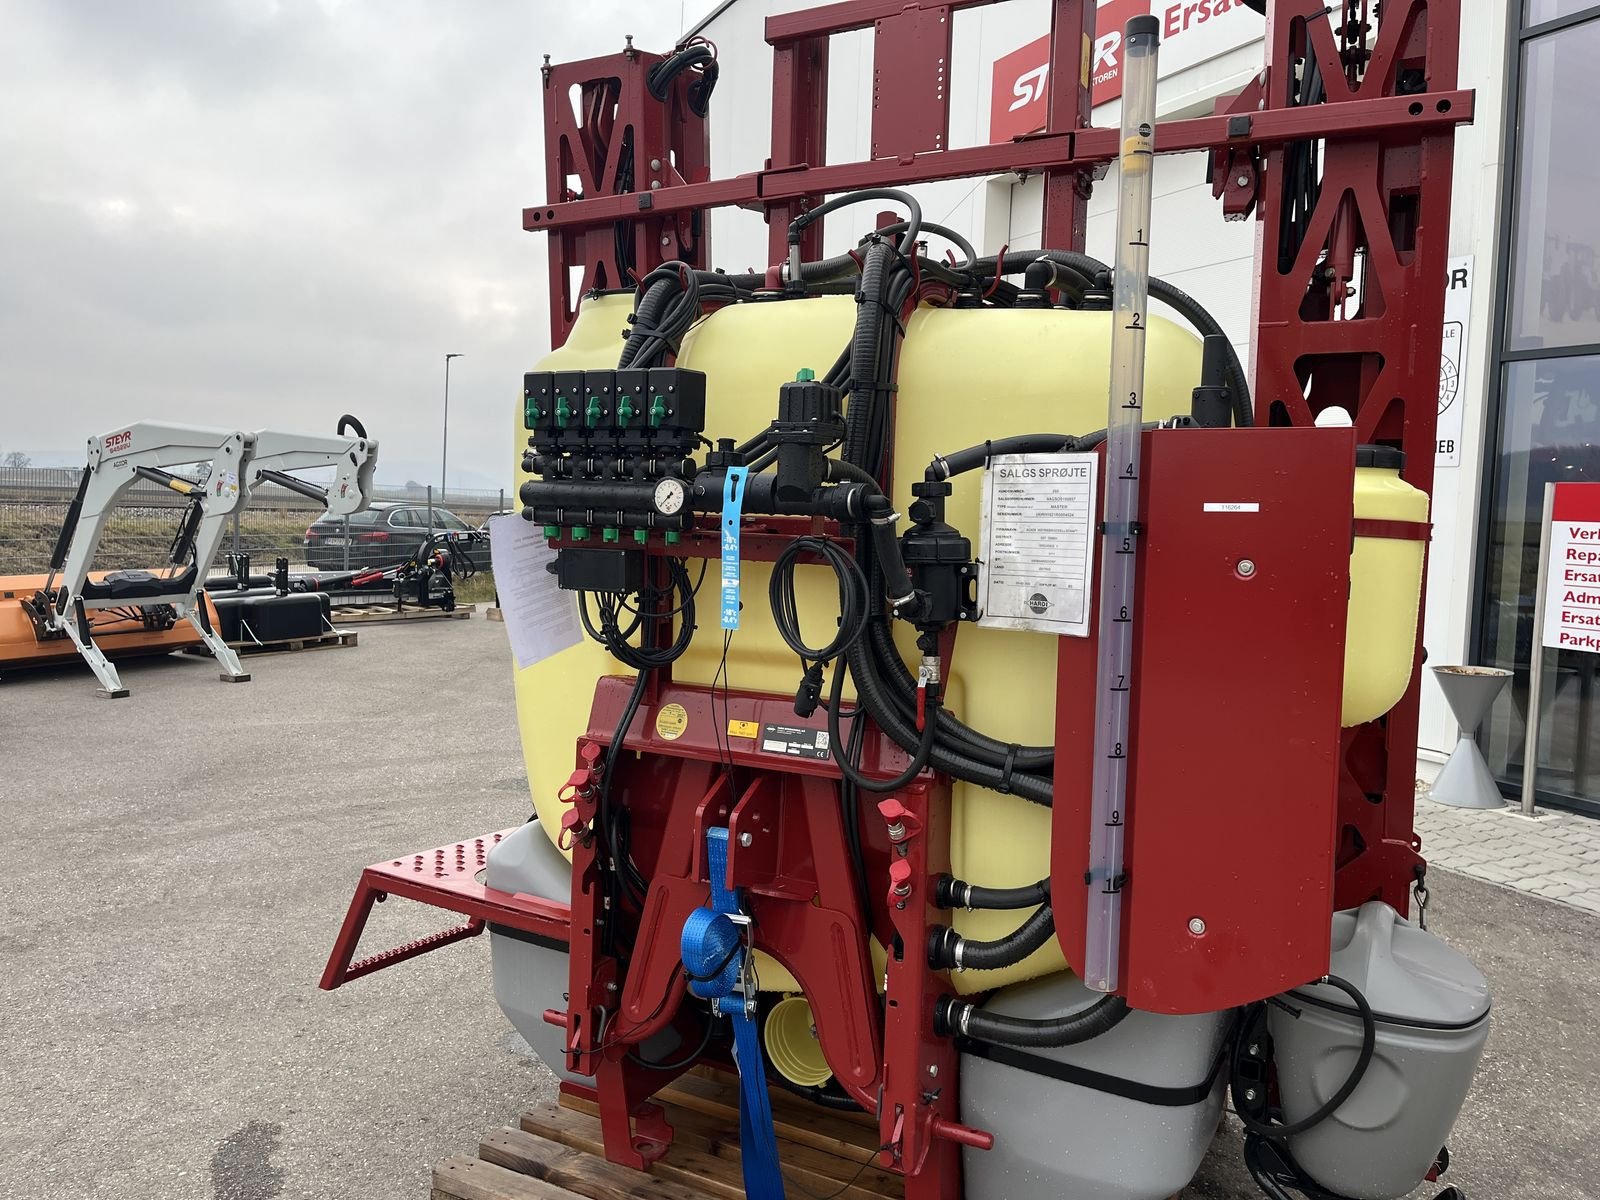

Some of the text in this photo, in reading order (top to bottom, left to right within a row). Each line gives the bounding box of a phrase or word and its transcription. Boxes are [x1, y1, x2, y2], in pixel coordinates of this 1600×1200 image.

[1164, 0, 1243, 39] Ersa
[1137, 229, 1142, 241] 1
[1133, 313, 1140, 326] 2
[1129, 392, 1136, 405] 3
[105, 431, 132, 448] STEYR
[1000, 468, 1087, 478] SALGS SPRØJTE
[1126, 463, 1133, 476] 4
[1123, 538, 1130, 550] 5
[1120, 606, 1127, 619] 6
[1117, 675, 1125, 688] 7
[1115, 743, 1121, 755] 8
[1112, 811, 1119, 823] 9
